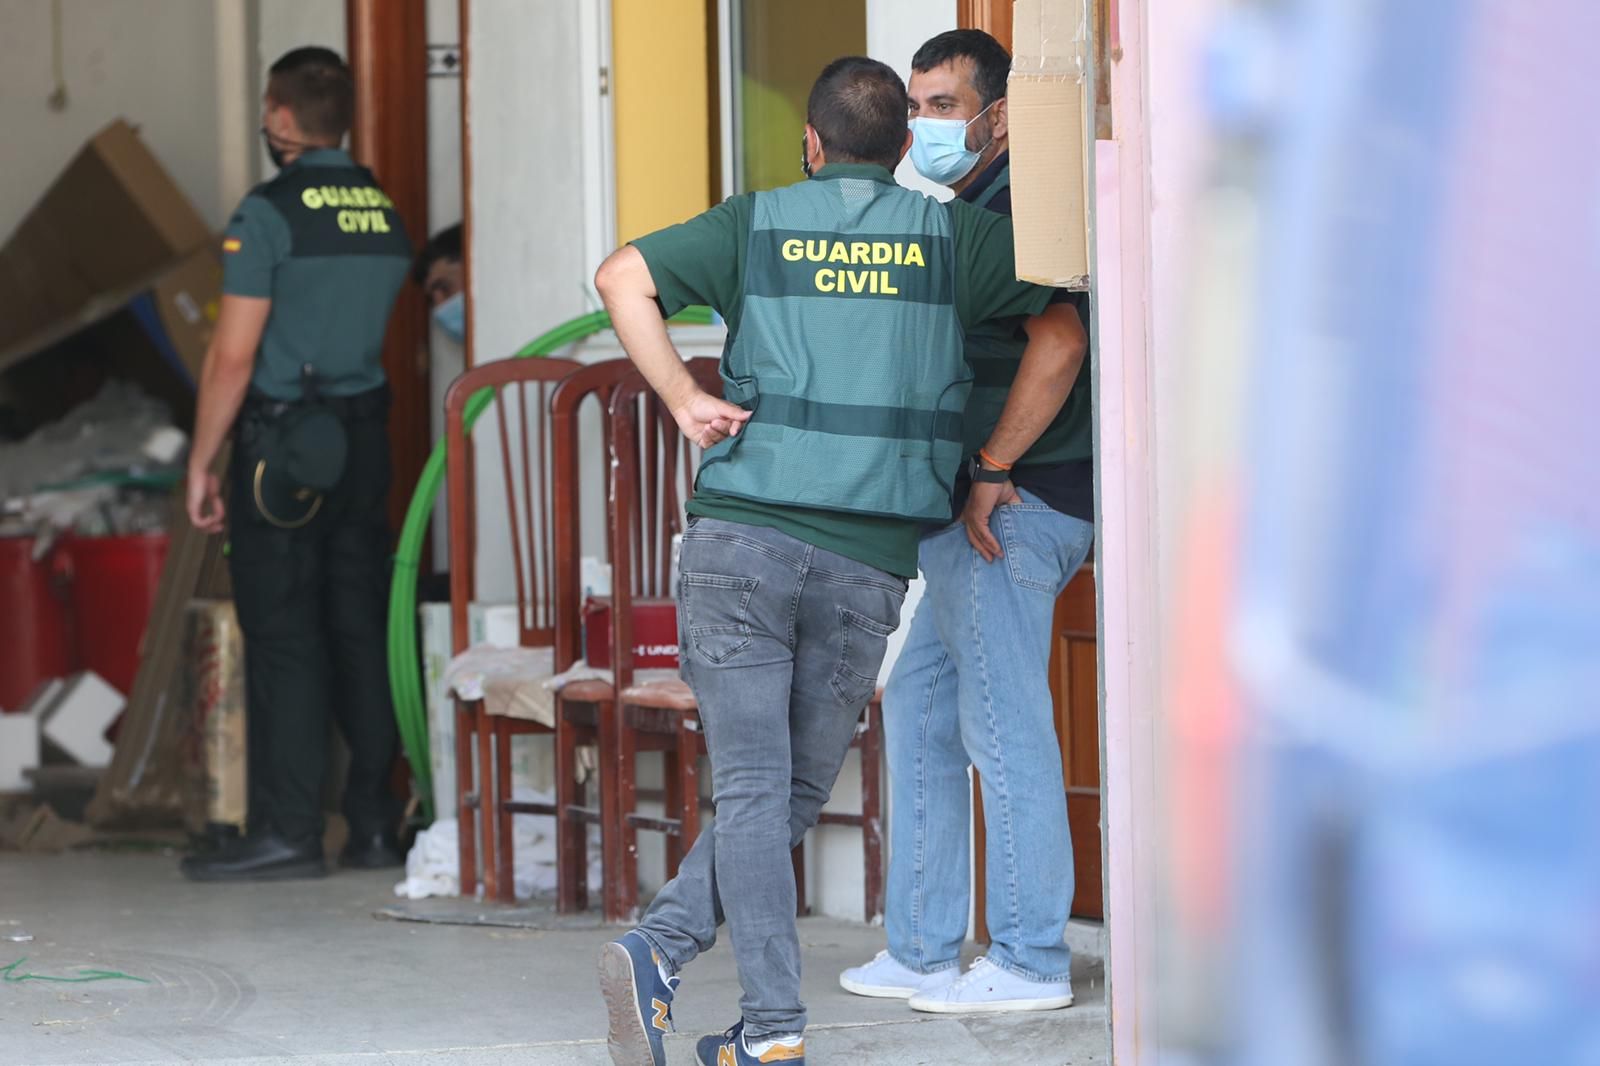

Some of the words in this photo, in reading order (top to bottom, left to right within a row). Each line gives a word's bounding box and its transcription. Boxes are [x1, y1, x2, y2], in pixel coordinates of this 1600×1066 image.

[337, 210, 391, 233] CIVIL
[781, 238, 926, 267] GUARDIA
[814, 268, 899, 295] CIVIL
[652, 997, 669, 1032] N
